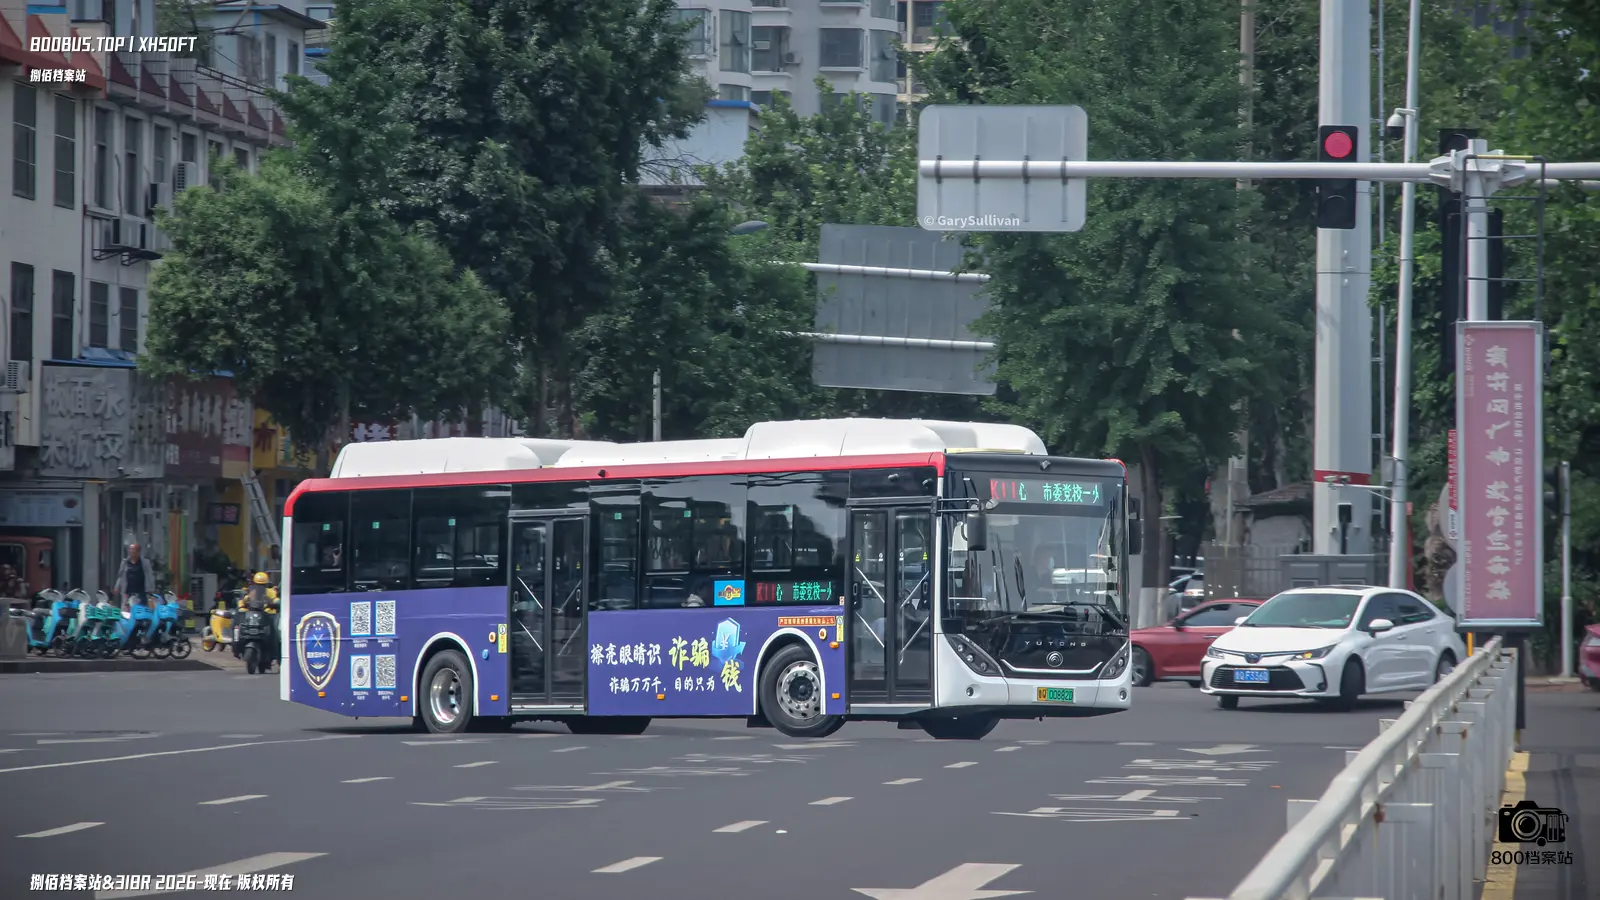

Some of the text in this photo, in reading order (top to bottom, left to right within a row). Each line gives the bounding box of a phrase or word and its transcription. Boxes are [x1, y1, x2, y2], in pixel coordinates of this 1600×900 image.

[590, 636, 710, 671] 擦亮眼睛识 诈骗
[720, 659, 743, 693] 钱
